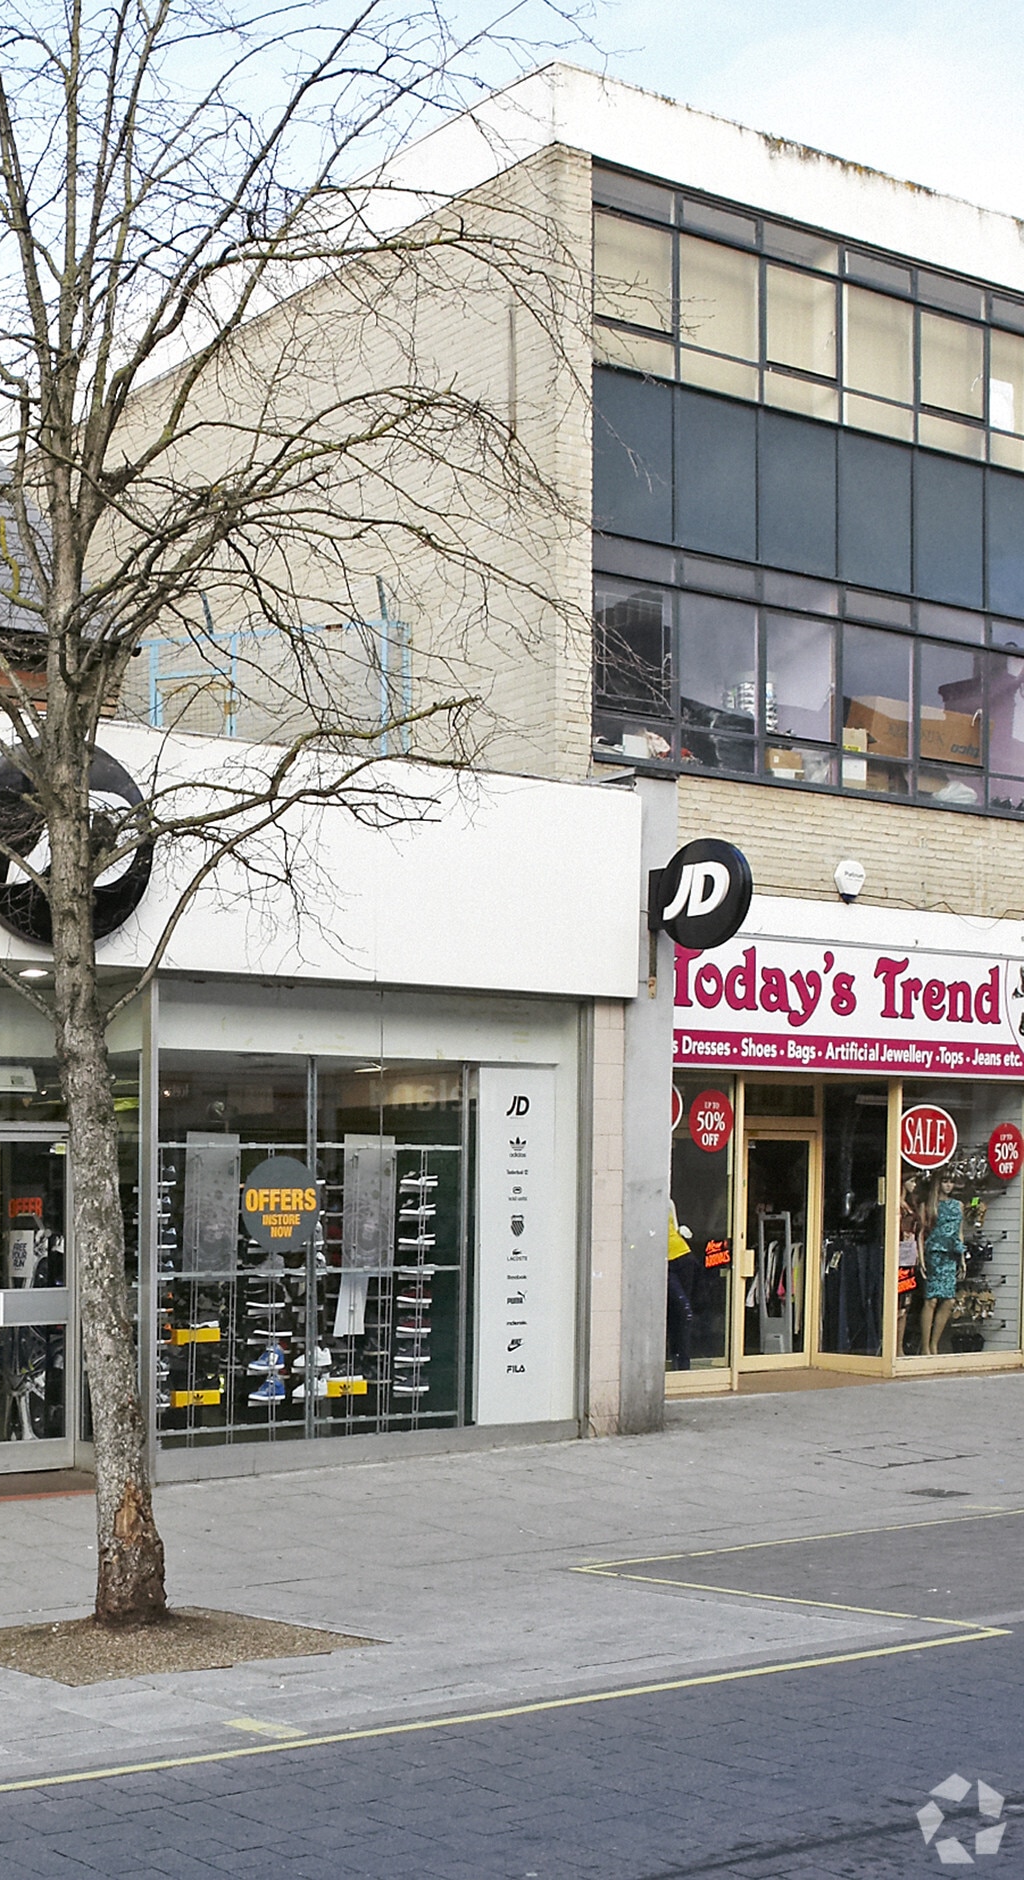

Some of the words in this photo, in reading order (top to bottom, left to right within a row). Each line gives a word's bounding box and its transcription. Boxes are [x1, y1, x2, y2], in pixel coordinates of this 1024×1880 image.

[663, 861, 730, 921] JD
[674, 943, 856, 1027] Today's
[874, 957, 1001, 1024] Trend
[682, 1035, 731, 1056] Dresses
[741, 1037, 777, 1058] Shoes
[787, 1040, 816, 1064] Bags
[825, 1041, 879, 1062] Artificial
[880, 1044, 933, 1069] Jewellery
[972, 1048, 1001, 1066] Jeans
[1004, 1051, 1023, 1067] etc.
[506, 1095, 530, 1117] JD
[696, 1111, 726, 1132] 50%
[701, 1132, 720, 1146] OFF
[904, 1117, 946, 1158] SALE
[994, 1142, 1019, 1162] 50%
[998, 1162, 1015, 1174] OFF
[246, 1187, 316, 1212] OFFERS
[262, 1213, 301, 1225] INSTORE
[270, 1226, 293, 1238] NOW
[507, 1364, 526, 1373] FILA
